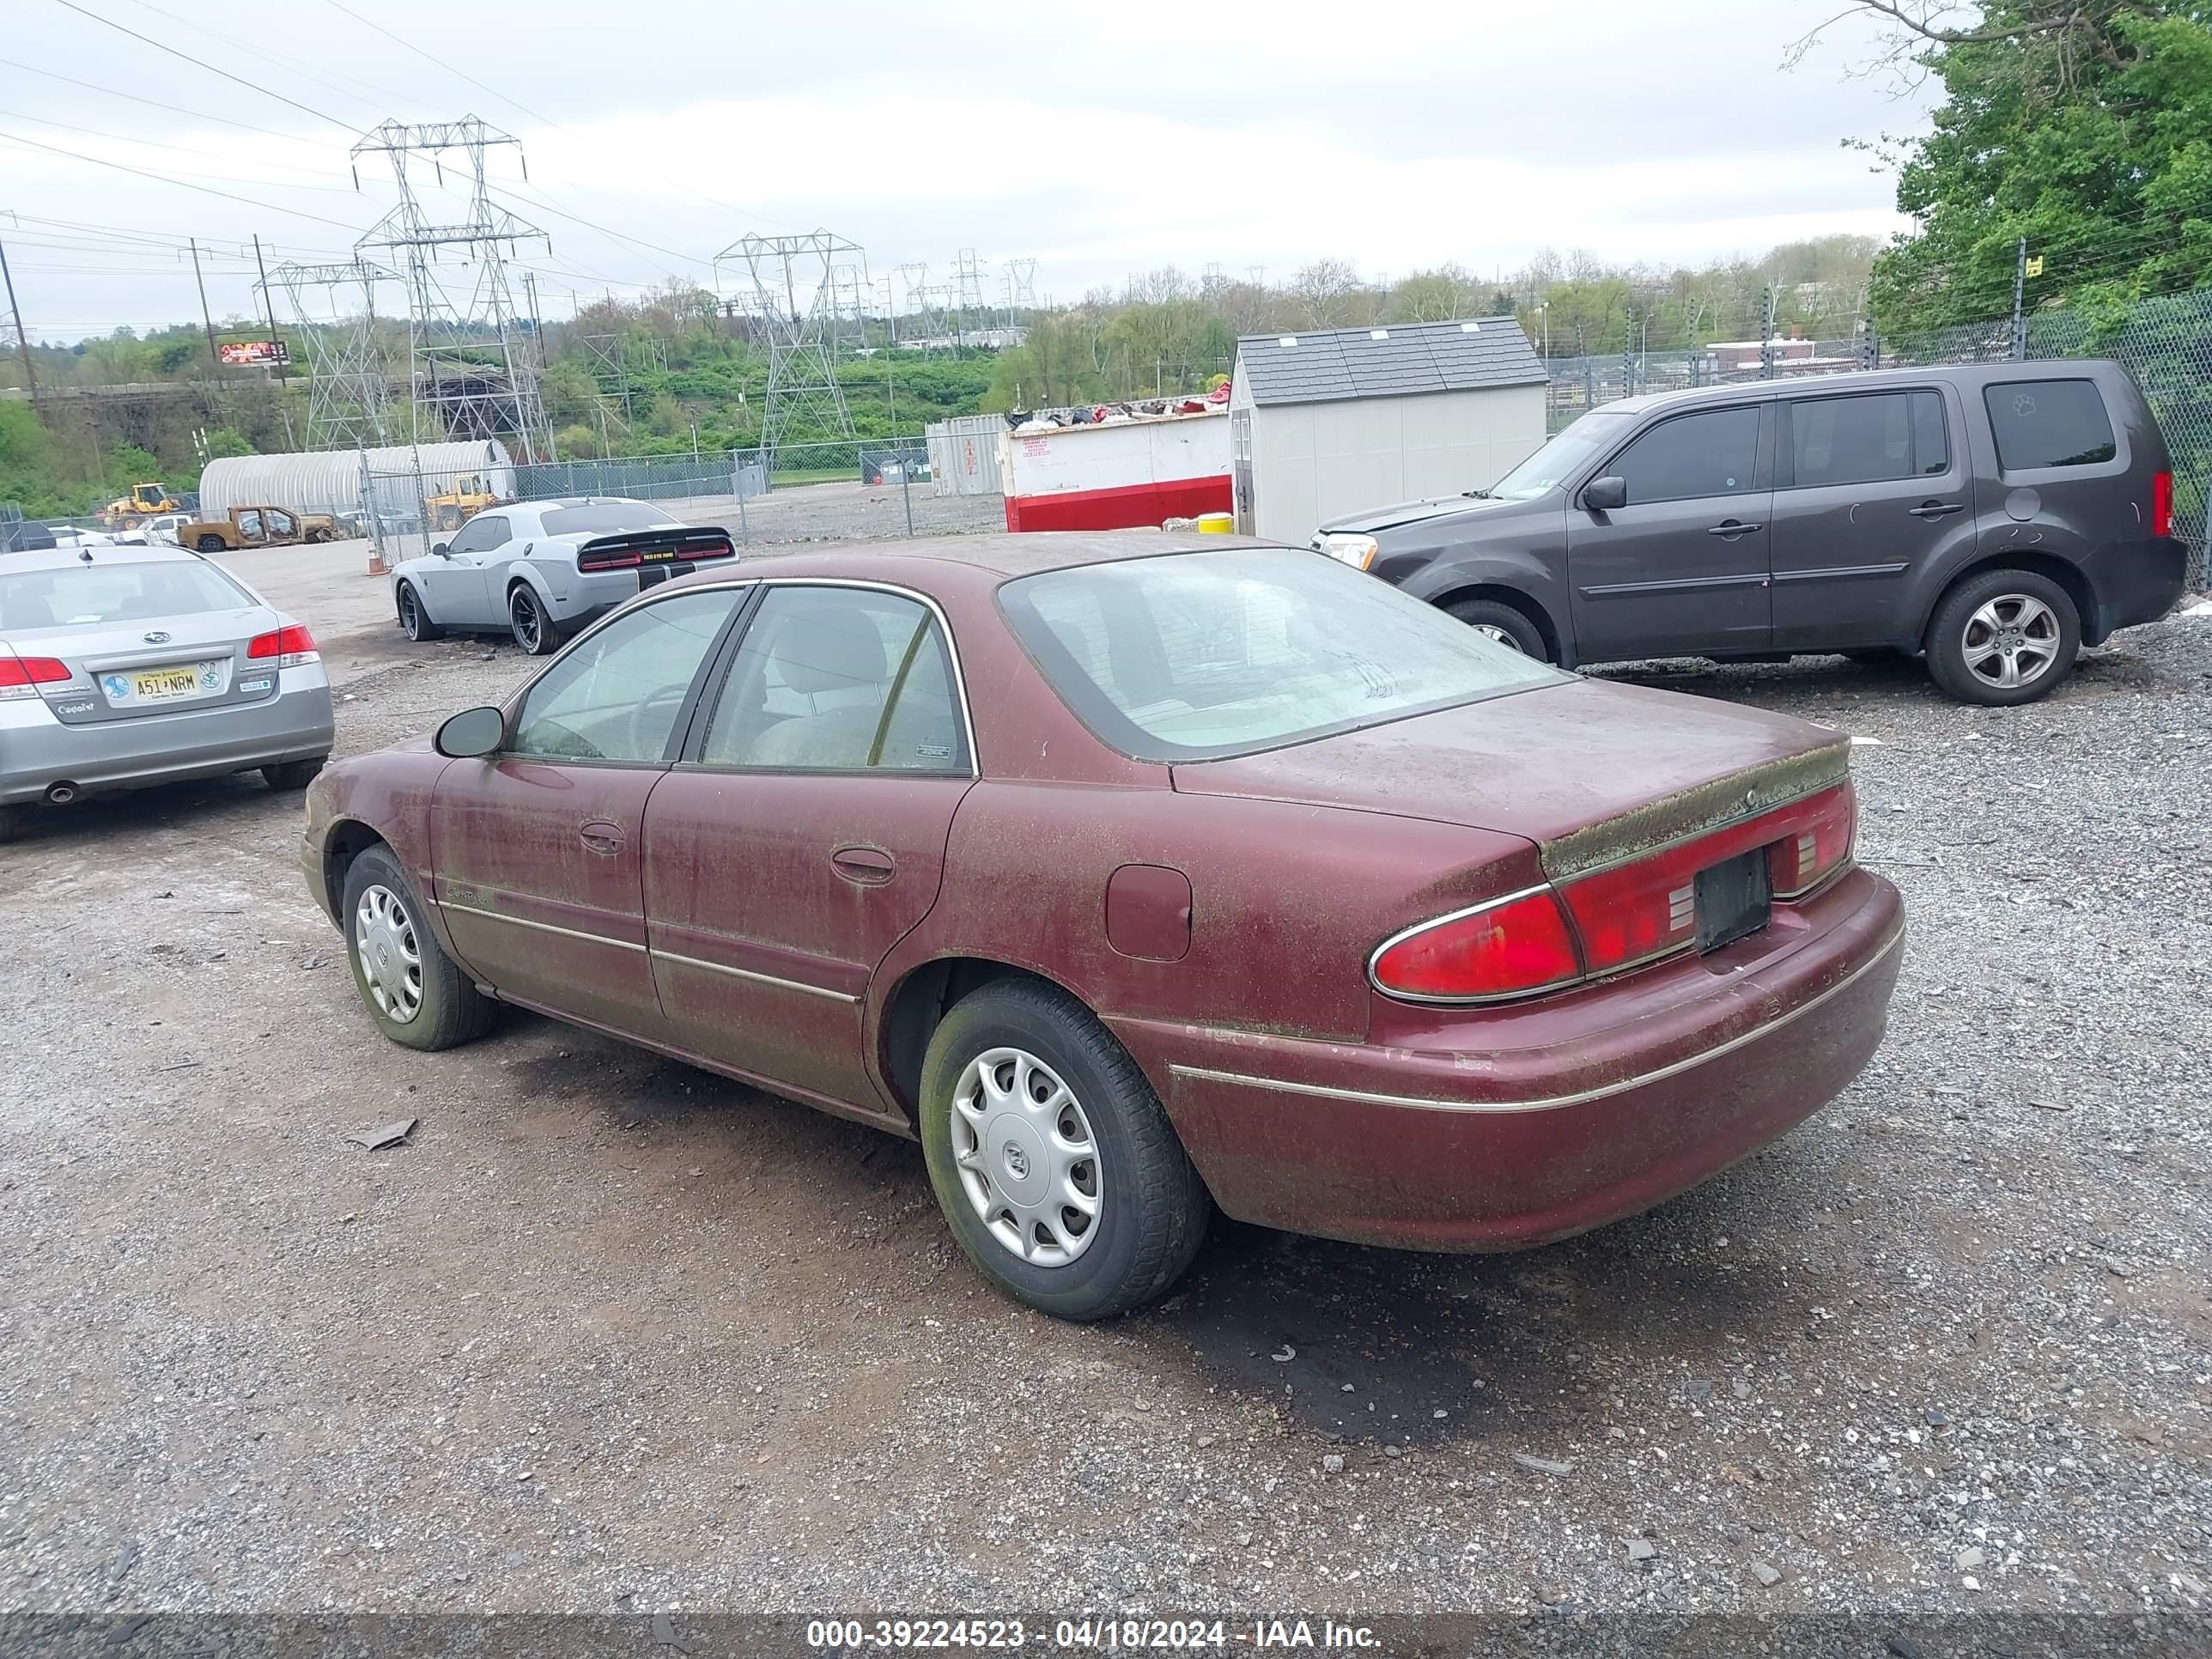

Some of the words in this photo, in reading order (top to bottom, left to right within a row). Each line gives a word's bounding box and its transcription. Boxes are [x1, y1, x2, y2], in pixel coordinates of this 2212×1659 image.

[964, 438, 977, 476] ITEL
[137, 679, 162, 696] A51
[168, 675, 195, 691] NRM
